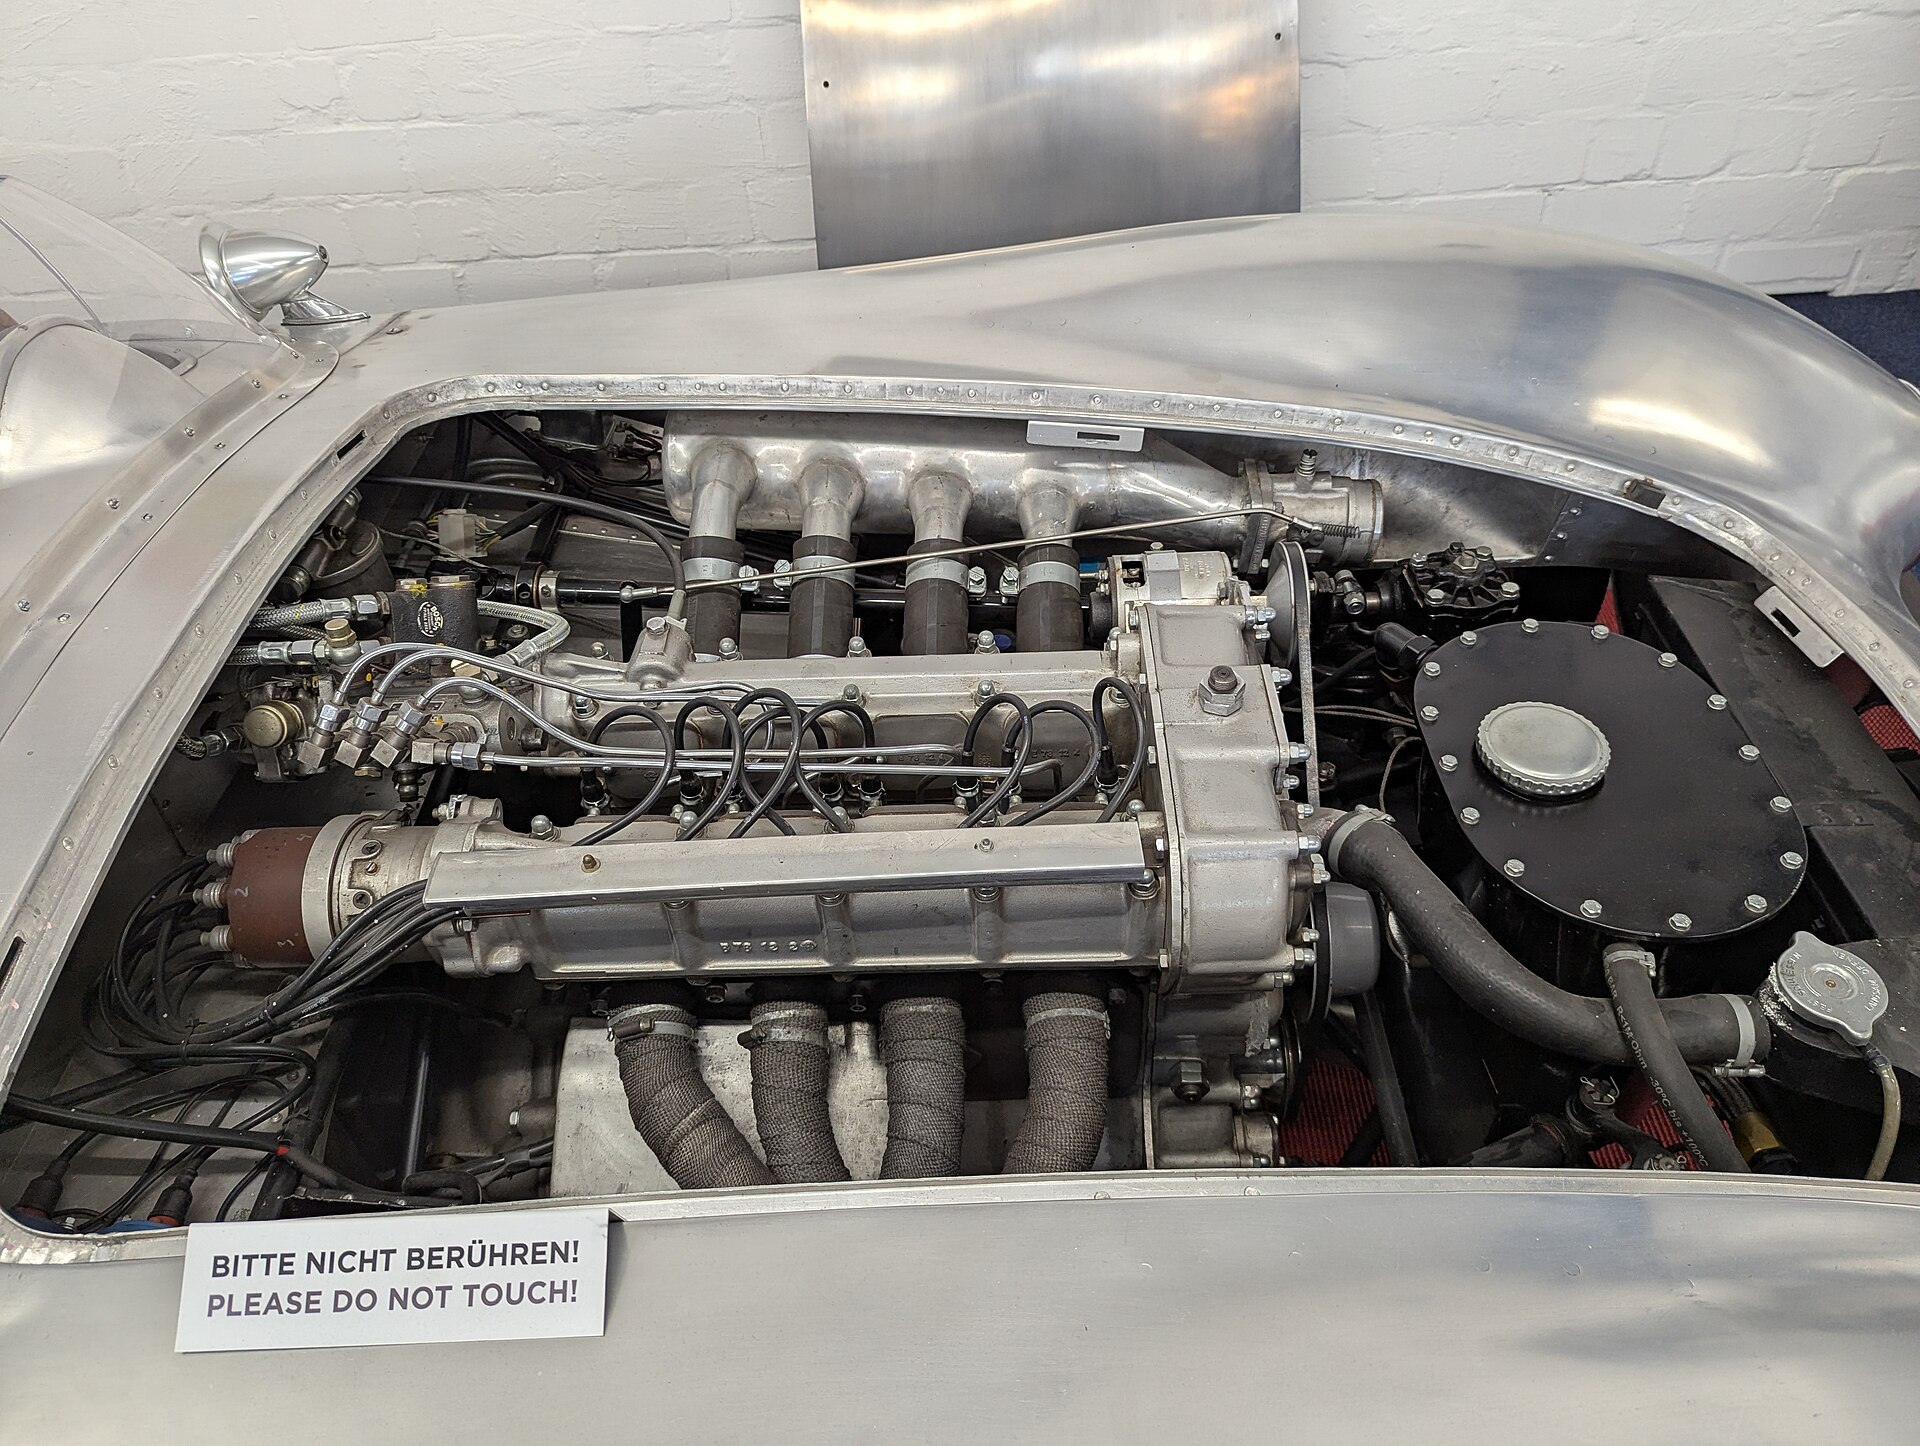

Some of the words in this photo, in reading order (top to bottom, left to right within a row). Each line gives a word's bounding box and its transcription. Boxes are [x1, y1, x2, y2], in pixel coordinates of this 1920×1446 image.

[430, 606, 441, 631] BOSCH
[1807, 998, 1833, 1014] FEST
[1864, 979, 1881, 1012] LANGSAM
[1667, 1109, 1682, 1128] bis
[211, 1252, 296, 1278] BITTE
[305, 1248, 398, 1275] NICHT
[406, 1239, 579, 1271] BERÜHREN!
[207, 1290, 323, 1318] PLEASE
[332, 1288, 378, 1313] DO
[388, 1285, 454, 1311] NOT
[462, 1279, 578, 1308] TOUCH!
